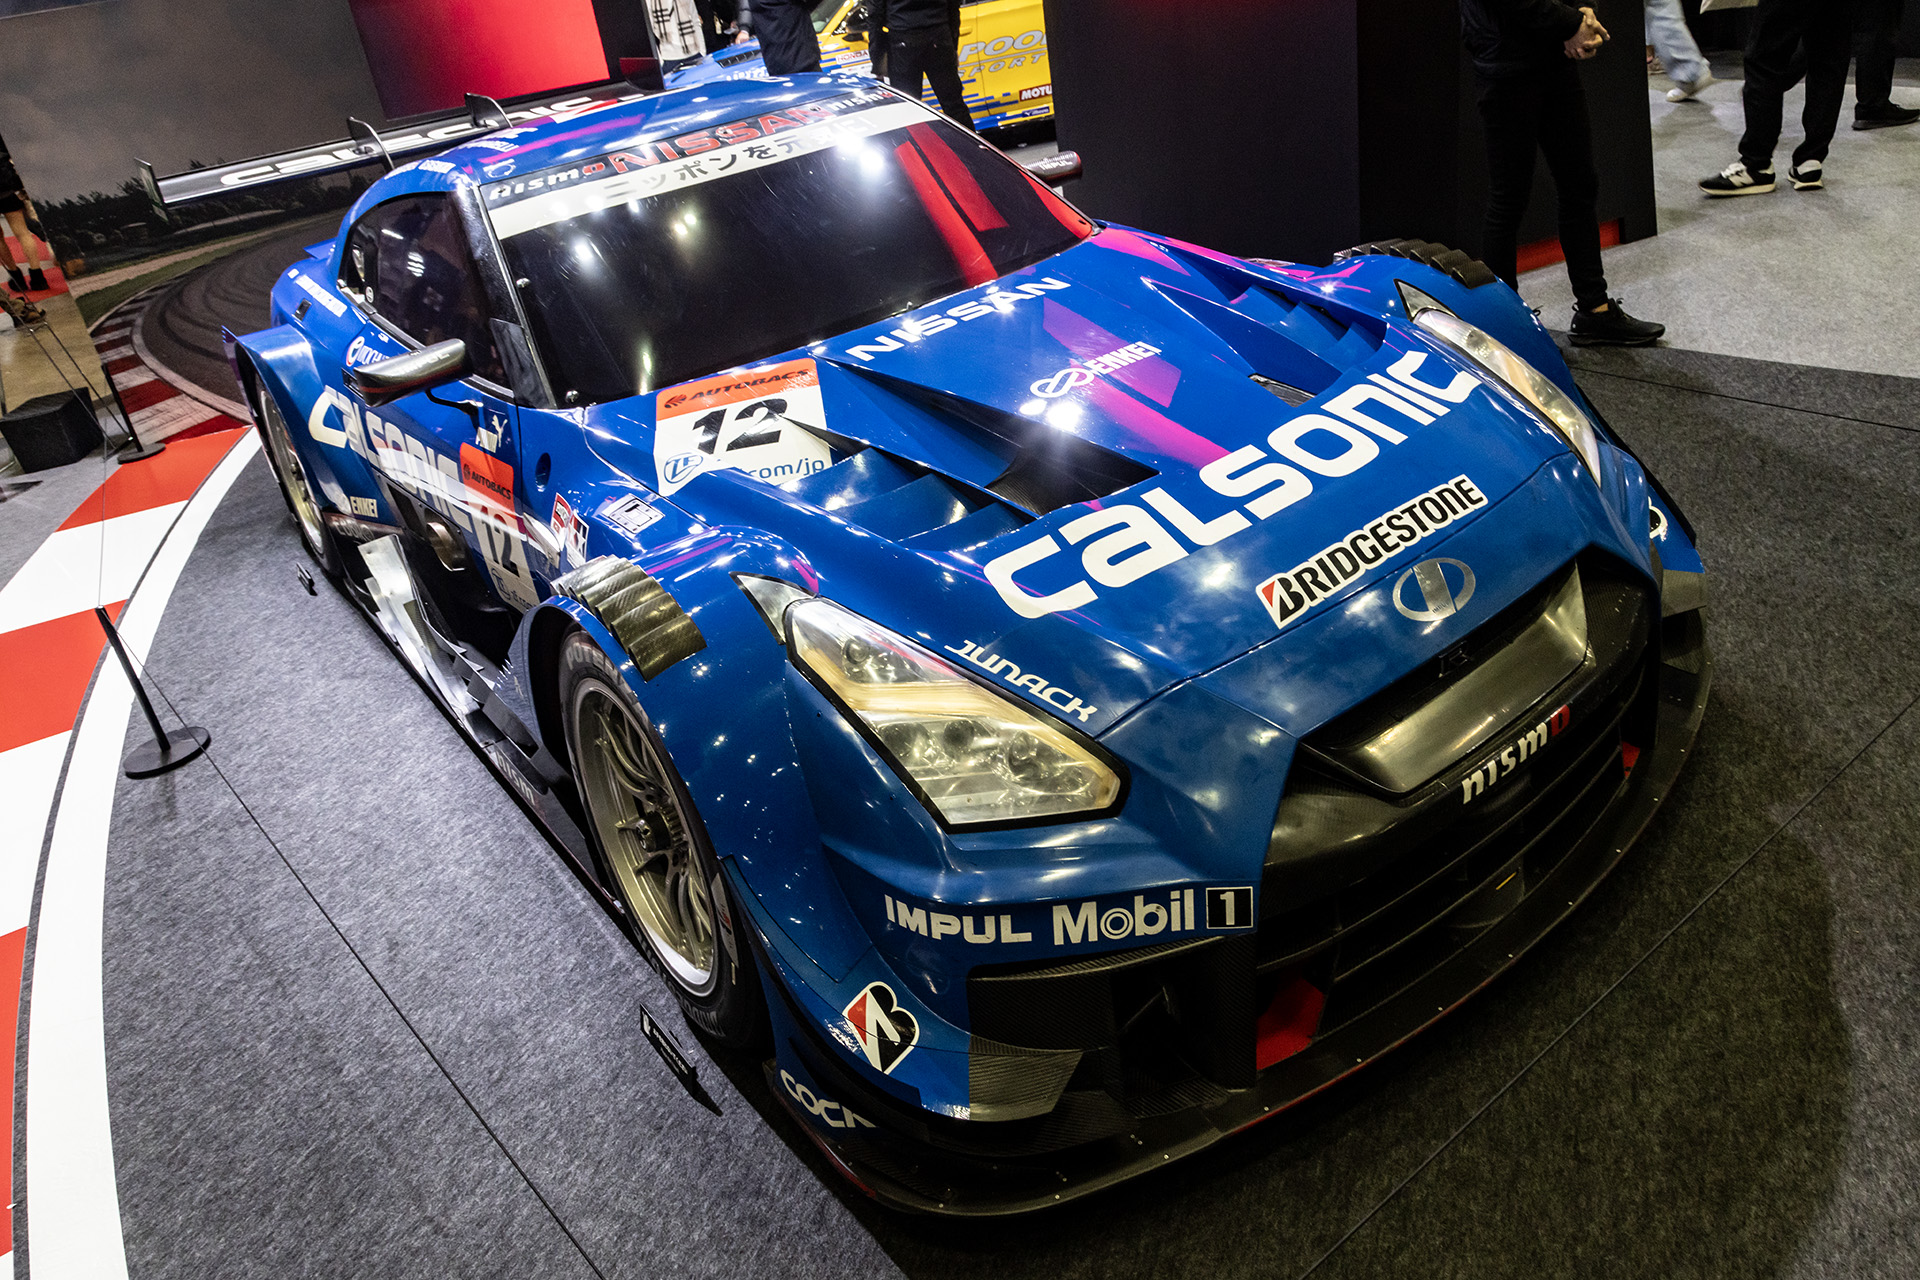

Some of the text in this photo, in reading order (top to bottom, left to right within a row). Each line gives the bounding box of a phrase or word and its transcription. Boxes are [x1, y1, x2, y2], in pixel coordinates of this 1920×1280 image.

[837, 50, 869, 61] HONDA
[958, 30, 1047, 63] POO
[489, 162, 605, 200] nismo
[608, 103, 835, 174] NISSAN
[845, 276, 1071, 362] NISSAN
[690, 368, 809, 401] AUTOBACS
[1089, 341, 1162, 375] ENKEI
[692, 398, 788, 455] 12
[471, 471, 512, 500] AUTOBACS
[480, 505, 520, 578] 12
[1261, 477, 1484, 626] BRIDGESTONE
[944, 640, 1099, 724] JUNACK
[884, 894, 1033, 945] IMPUL
[1052, 889, 1195, 945] Mobil
